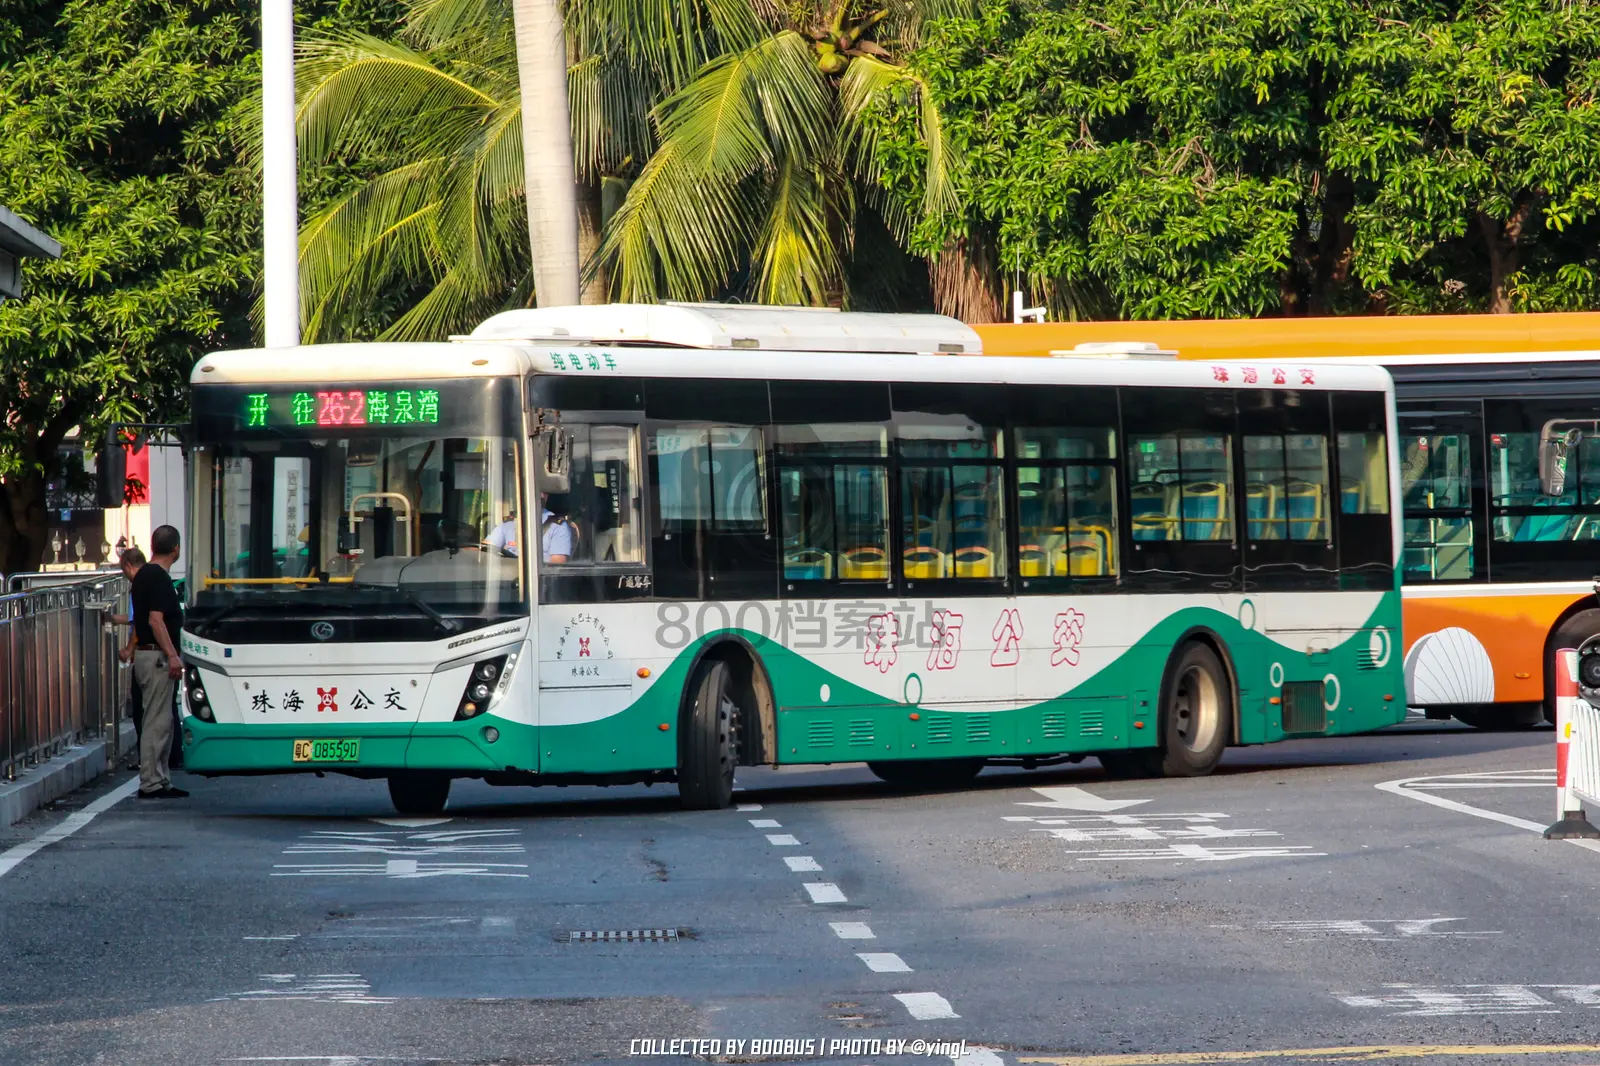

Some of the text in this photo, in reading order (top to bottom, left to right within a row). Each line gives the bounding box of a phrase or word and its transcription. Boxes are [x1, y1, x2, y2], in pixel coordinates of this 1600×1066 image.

[549, 352, 617, 371] 纯电动车
[1211, 366, 1315, 385] 珠海公交
